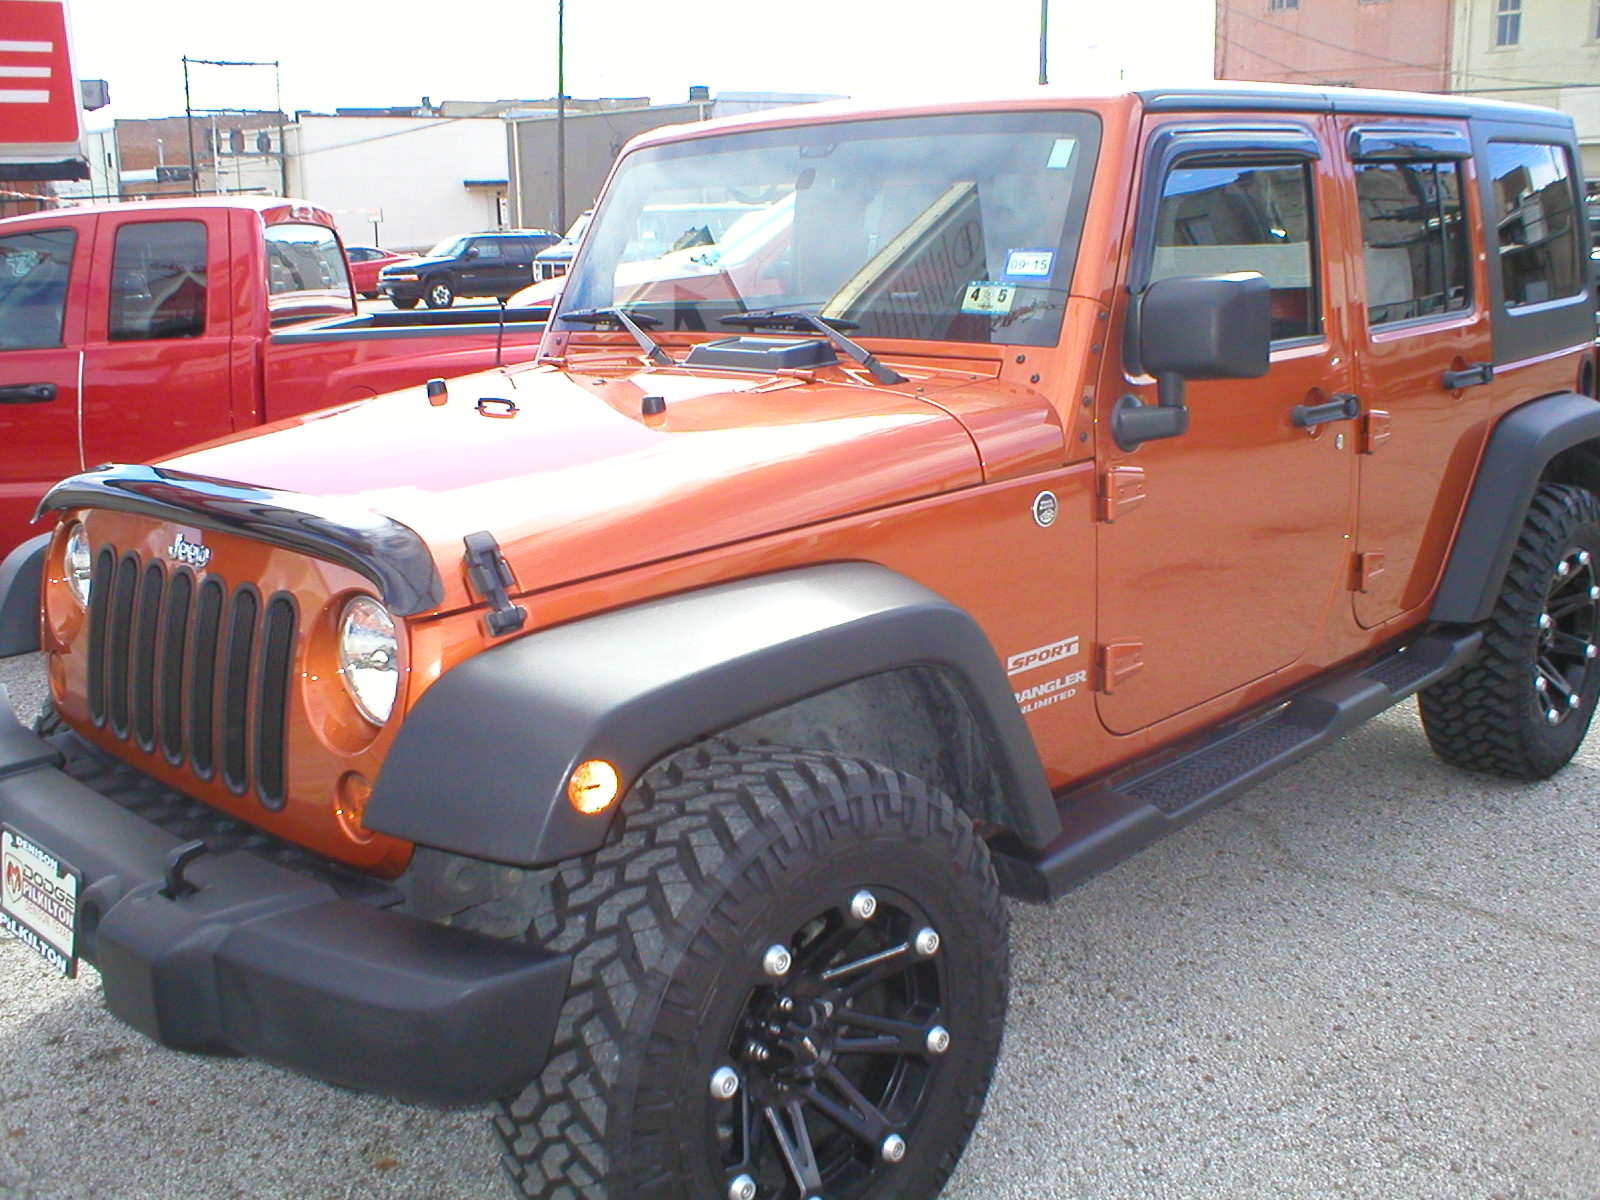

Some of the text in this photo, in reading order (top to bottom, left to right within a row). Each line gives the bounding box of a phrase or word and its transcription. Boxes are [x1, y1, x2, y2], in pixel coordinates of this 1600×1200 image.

[168, 533, 210, 567] Jeep
[1008, 640, 1079, 671] SPORT
[16, 835, 58, 872] DENISON
[23, 864, 76, 910] DODGE
[23, 882, 74, 928] PILKILTON
[0, 912, 67, 973] PILKILTON
